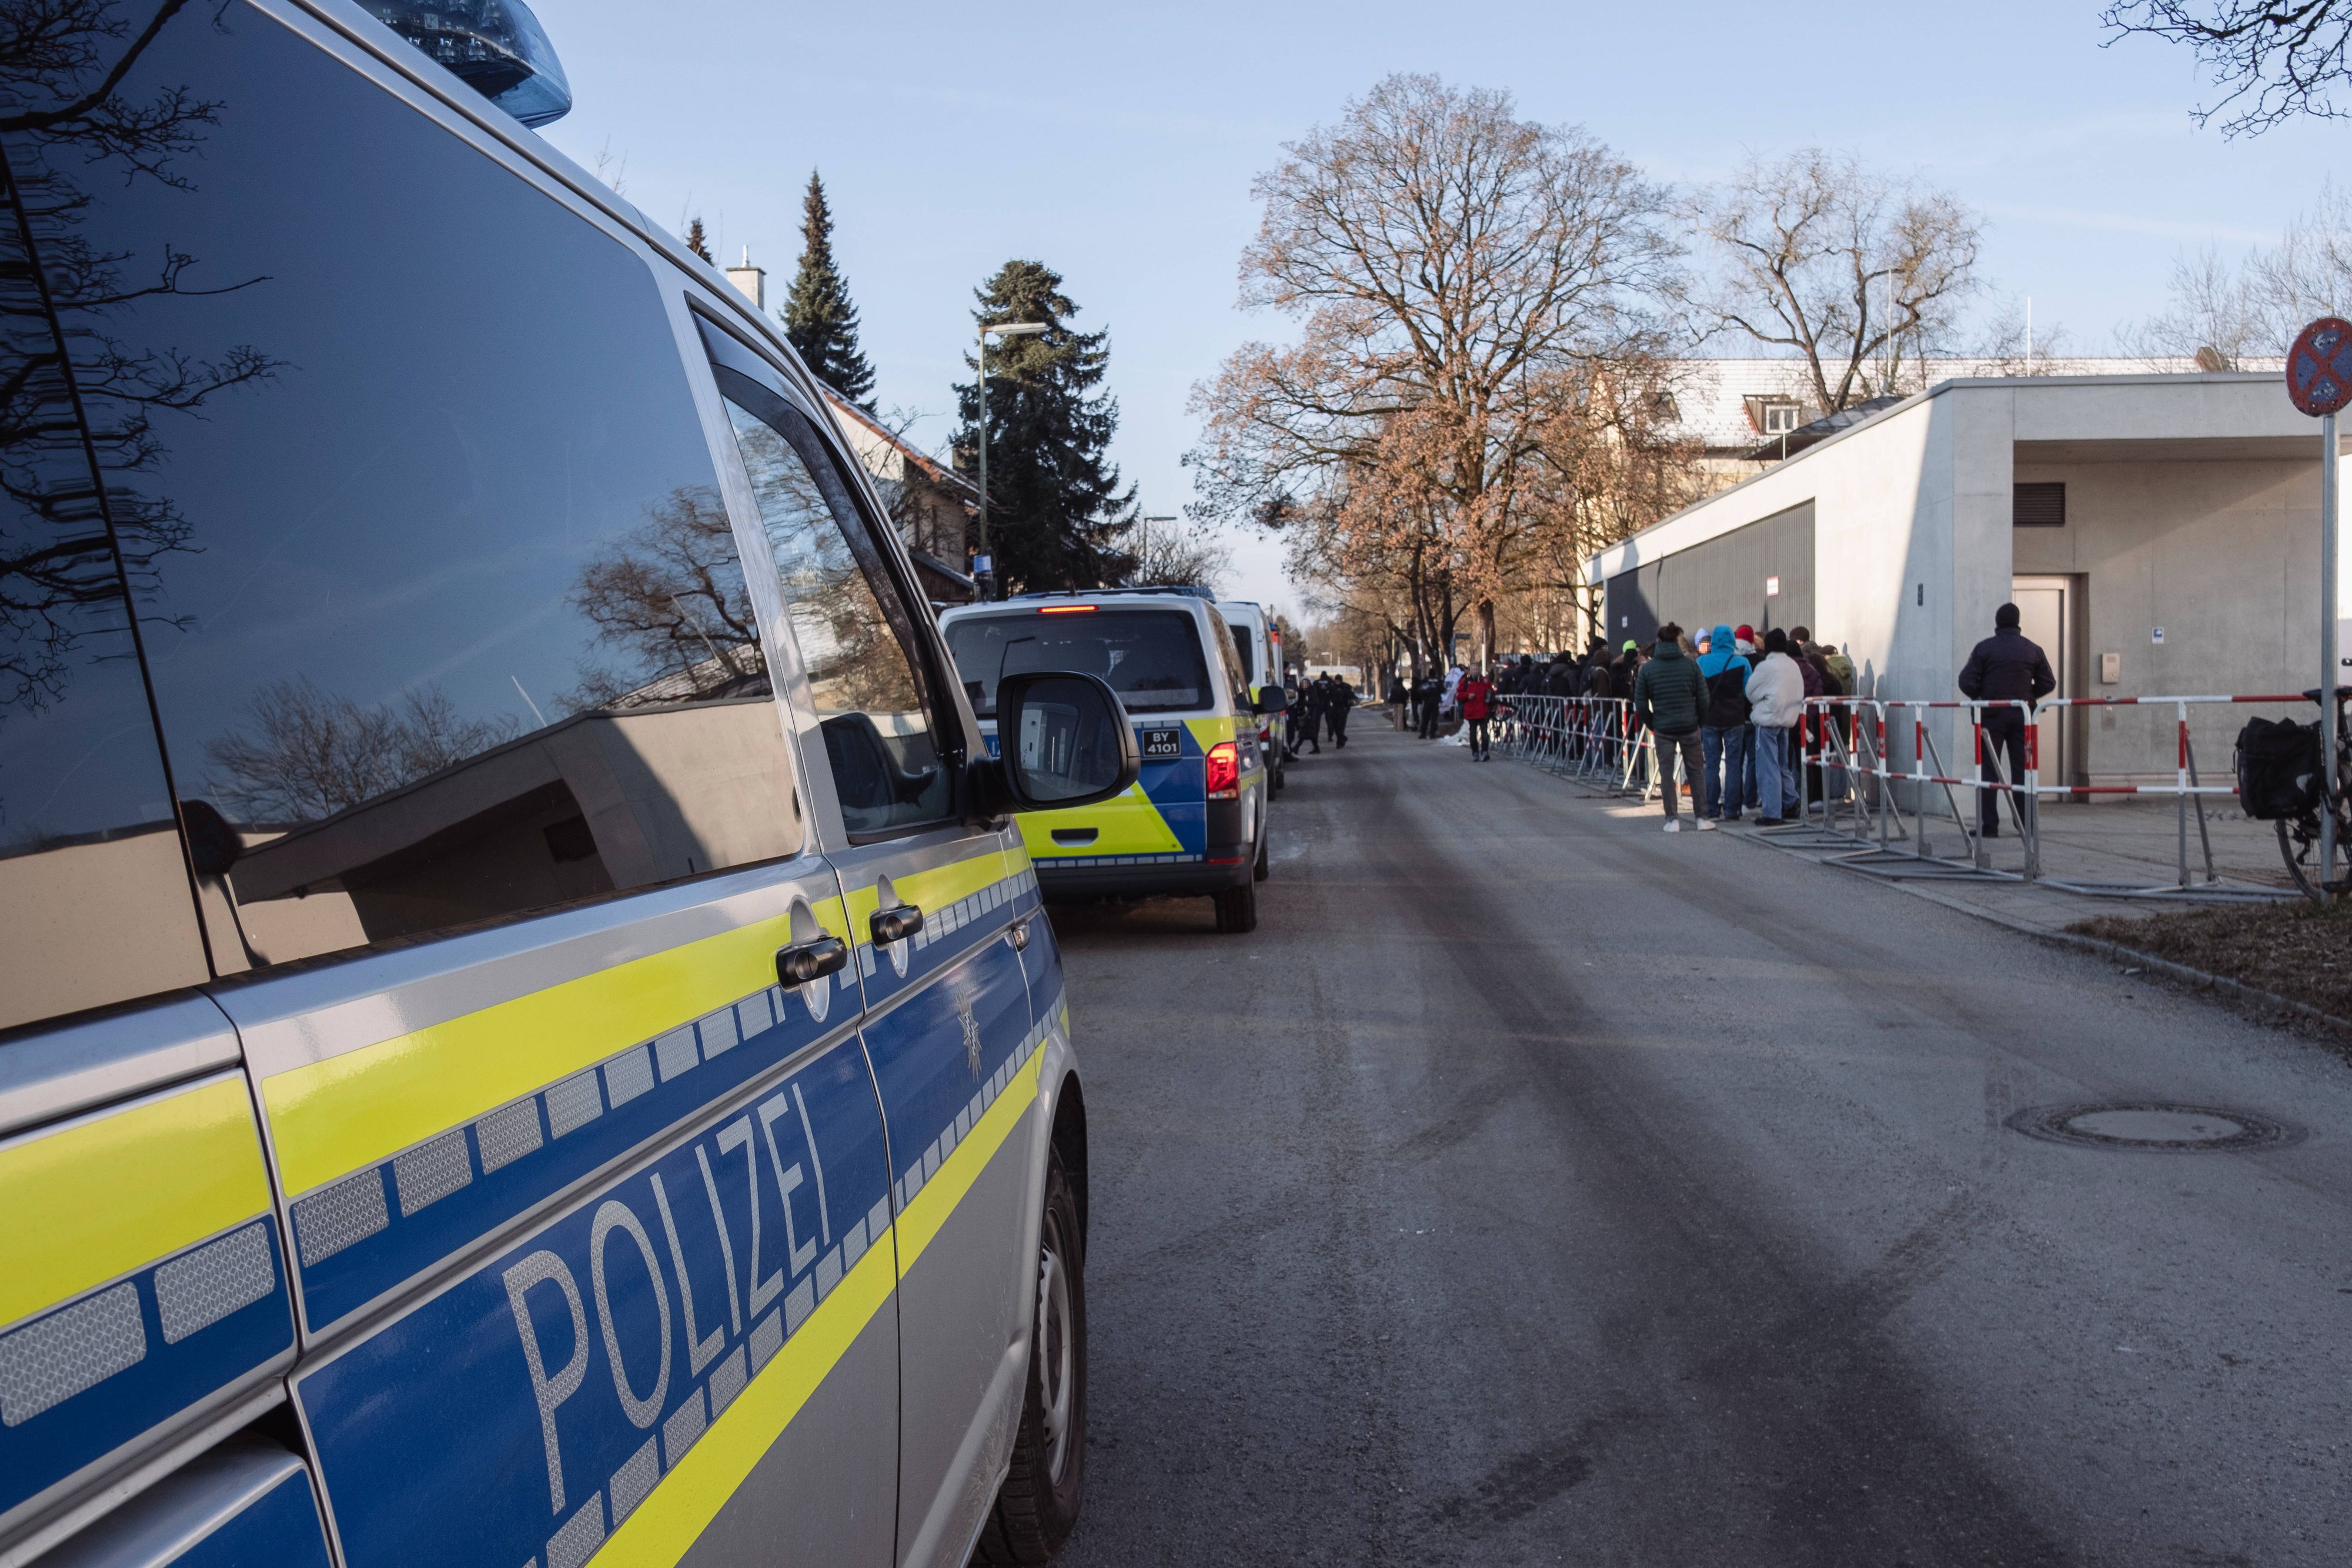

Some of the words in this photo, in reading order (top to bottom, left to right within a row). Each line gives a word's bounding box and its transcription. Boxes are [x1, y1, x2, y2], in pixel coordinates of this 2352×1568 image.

[1153, 732, 1169, 742] BY
[1147, 743, 1177, 753] 4101
[502, 1082, 830, 1516] POLIZEI
